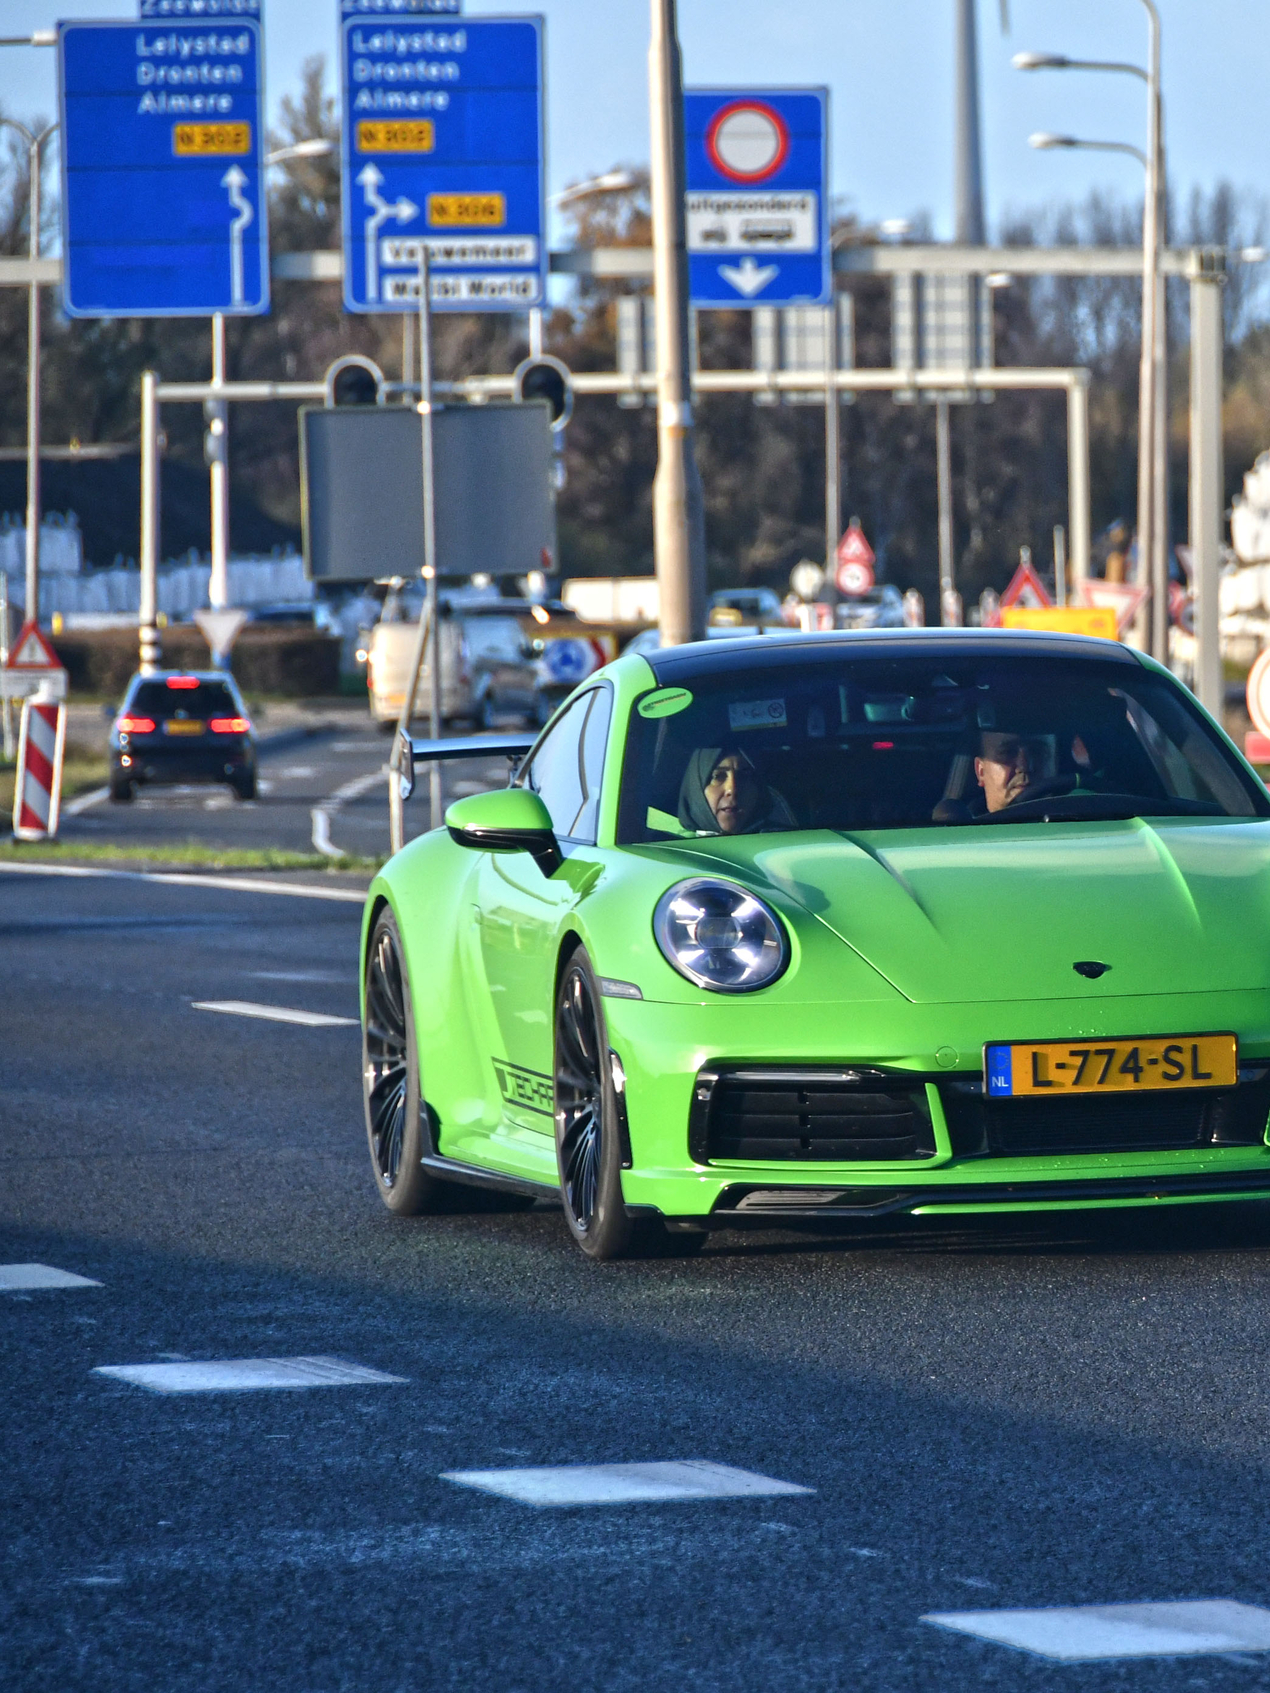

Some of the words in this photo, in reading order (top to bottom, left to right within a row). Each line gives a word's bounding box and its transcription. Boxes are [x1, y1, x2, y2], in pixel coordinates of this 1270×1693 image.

[136, 32, 250, 59] Lelystad
[352, 28, 467, 57] Lelystad
[137, 63, 243, 86] Dronten
[352, 59, 460, 83] Dronten
[137, 91, 234, 114] Almere
[354, 88, 449, 112] Almere
[388, 242, 526, 261] Veuwemeer
[392, 278, 460, 297] Waibi
[469, 278, 532, 297] World
[1031, 1044, 1212, 1088] L-774-SL
[991, 1076, 1009, 1088] NL
